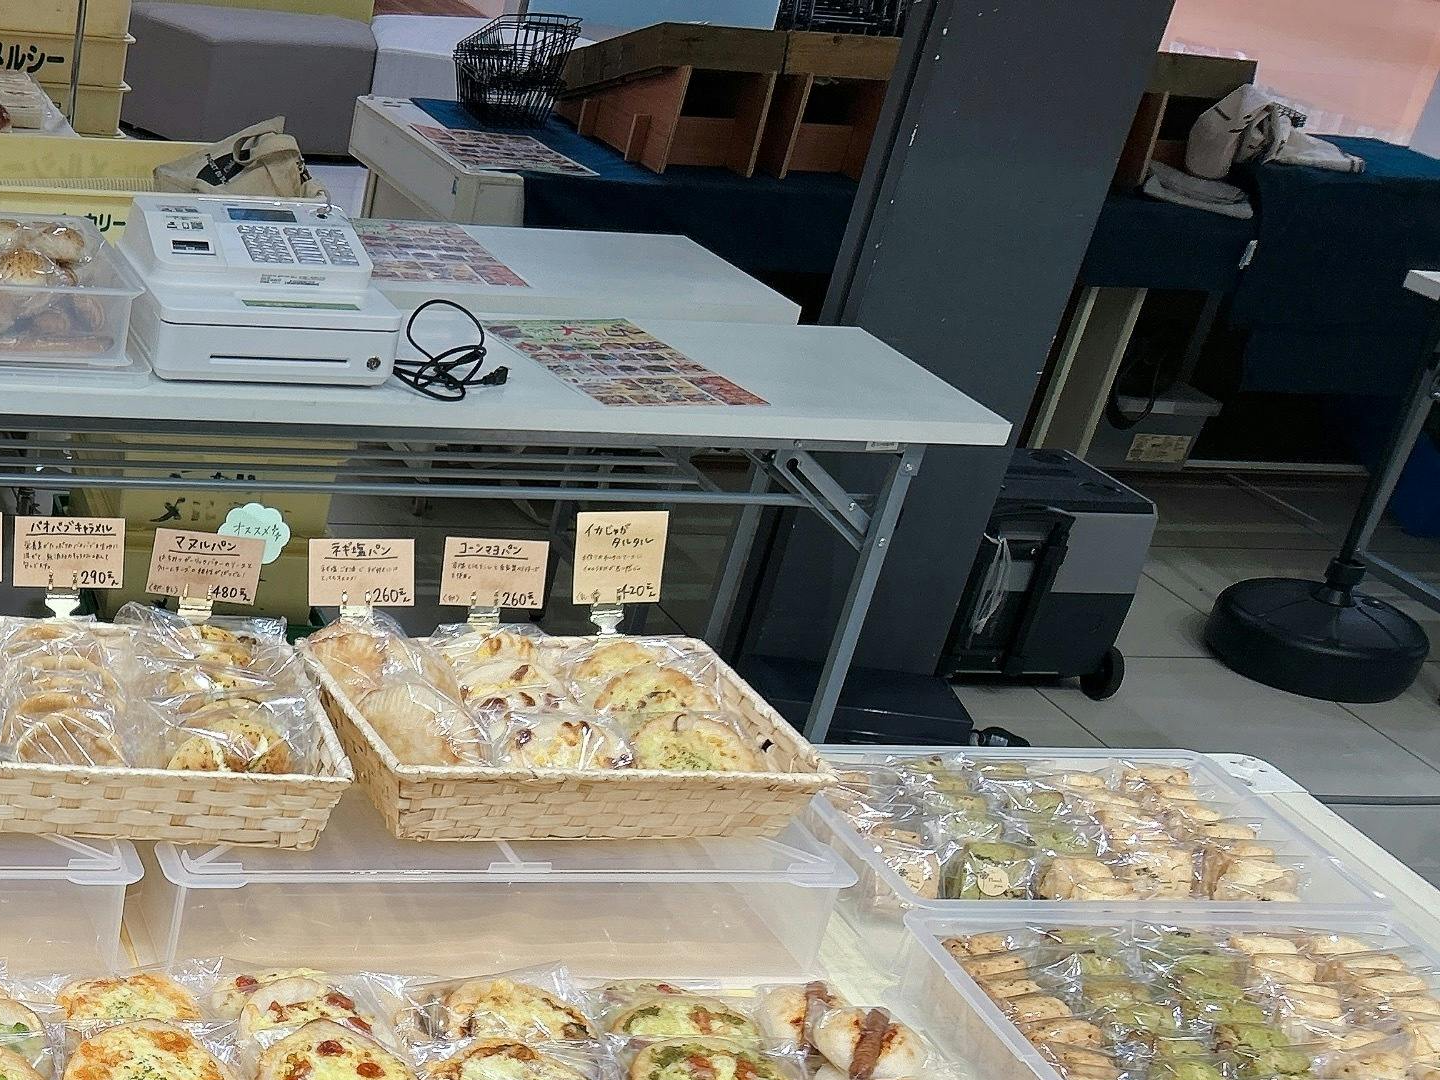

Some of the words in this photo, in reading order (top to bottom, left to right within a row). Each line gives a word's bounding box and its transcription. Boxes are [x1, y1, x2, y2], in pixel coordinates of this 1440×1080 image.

[584, 522, 631, 537] イカじゃが
[175, 536, 237, 551] マヌルパン
[331, 542, 392, 557] ネギ塩パン
[459, 543, 522, 555] コーンマヨパン
[612, 537, 654, 548] タルタル
